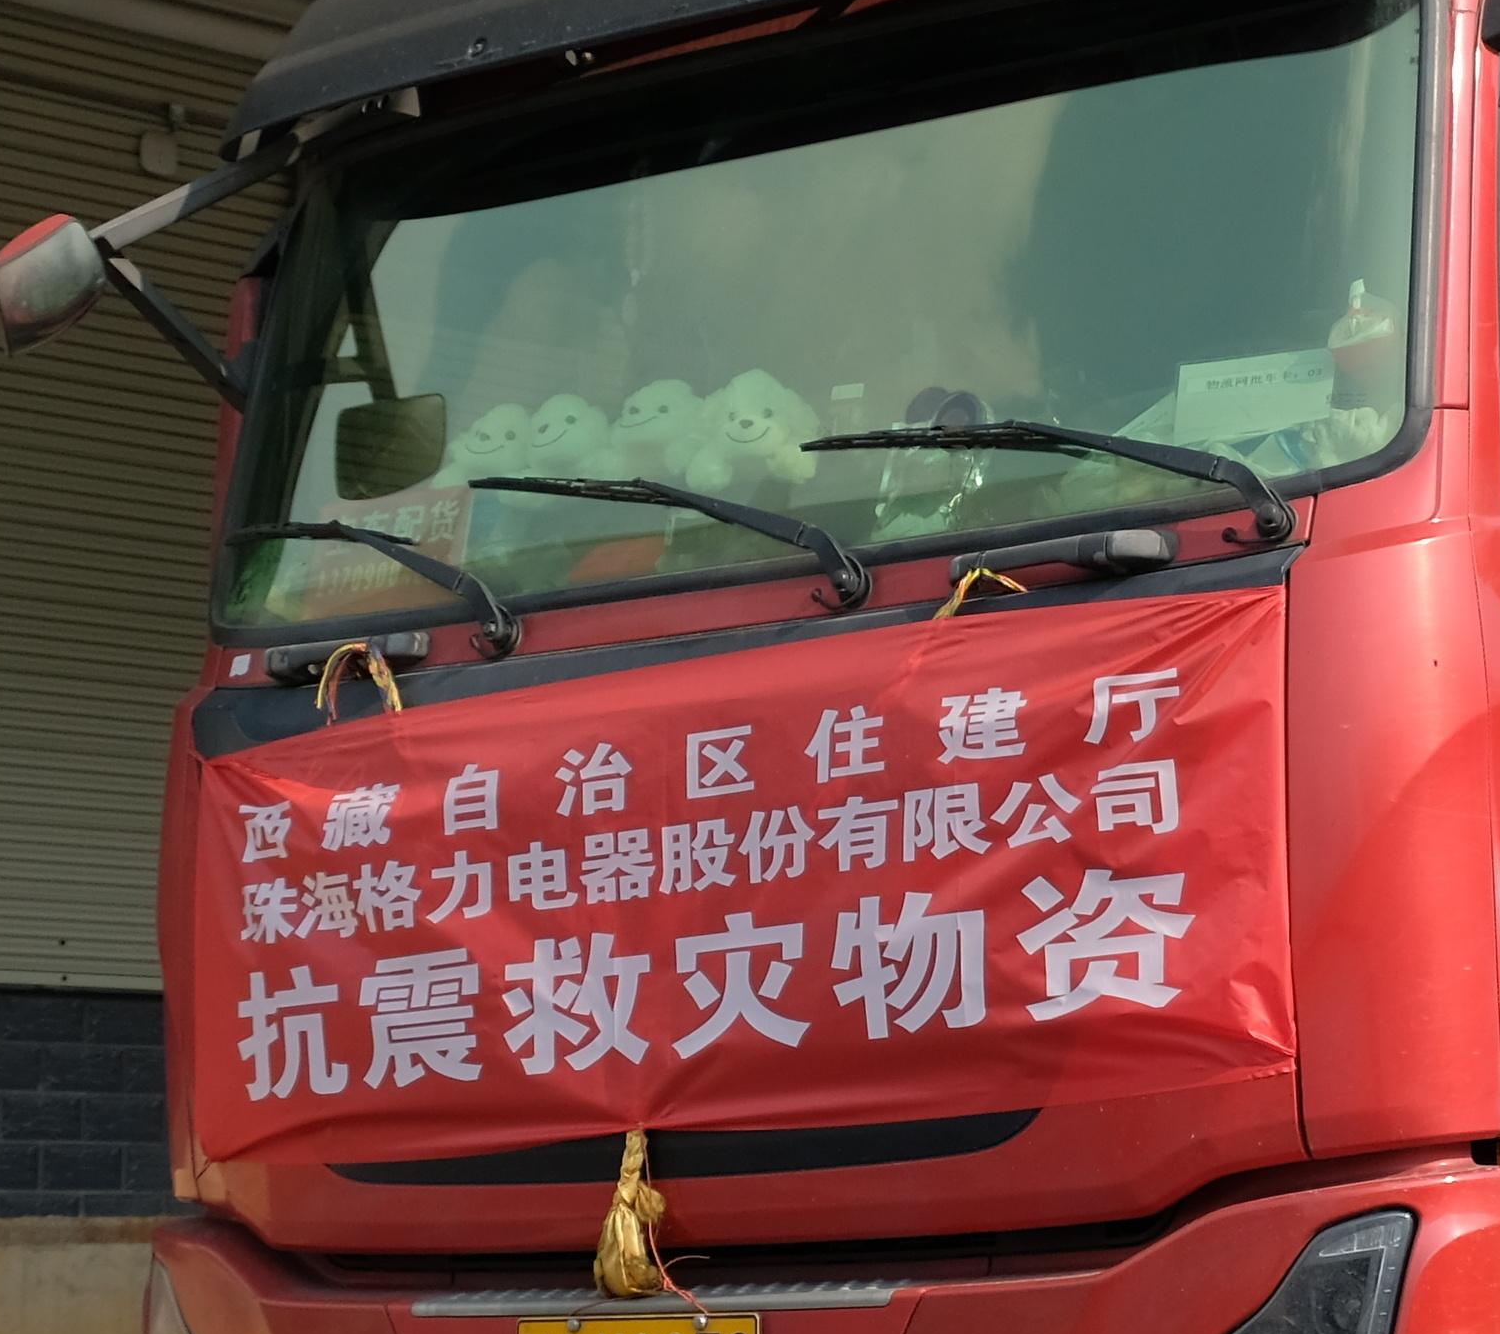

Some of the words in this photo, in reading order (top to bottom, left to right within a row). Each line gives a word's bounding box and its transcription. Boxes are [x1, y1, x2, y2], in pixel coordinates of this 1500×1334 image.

[240, 667, 1180, 865] 西藏自治区住建厅
[240, 758, 1180, 946] 珠海格力电器股份有限公司
[235, 867, 1197, 1102] 抗震救灾物资
